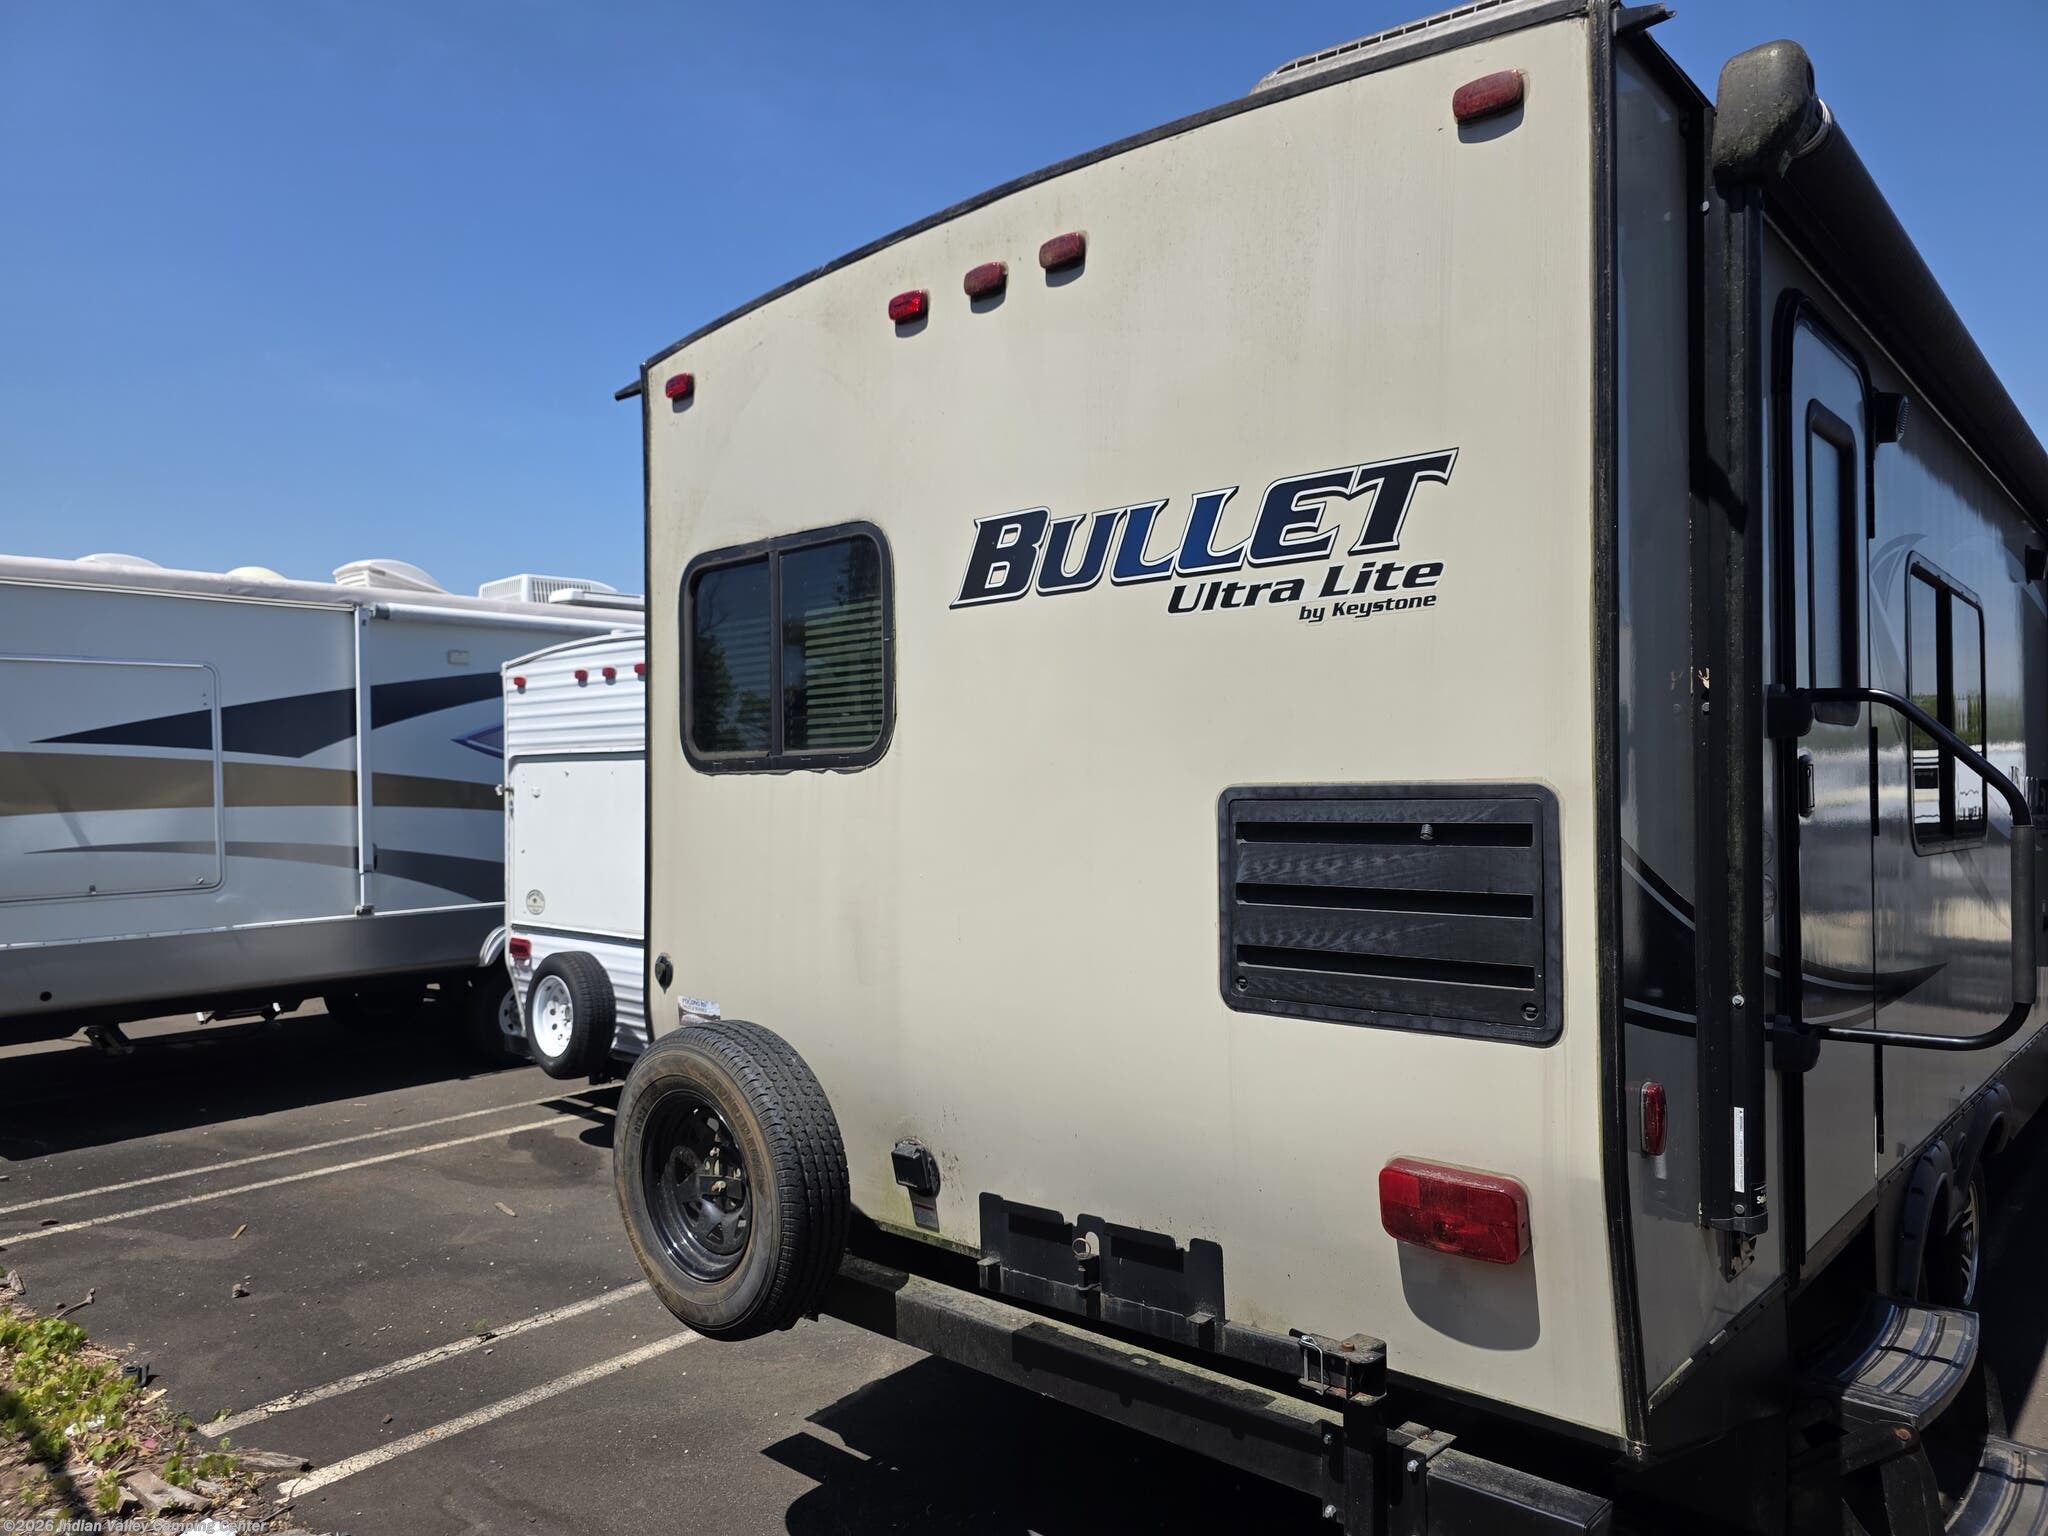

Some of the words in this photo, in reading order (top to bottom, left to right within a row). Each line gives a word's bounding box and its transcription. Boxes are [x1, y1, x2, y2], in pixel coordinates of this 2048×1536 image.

[949, 447, 1459, 609] BULLET
[1168, 579, 1305, 613] Ultra
[1318, 561, 1444, 598] Lite
[1299, 605, 1325, 623] by
[1331, 594, 1437, 619] Keystone
